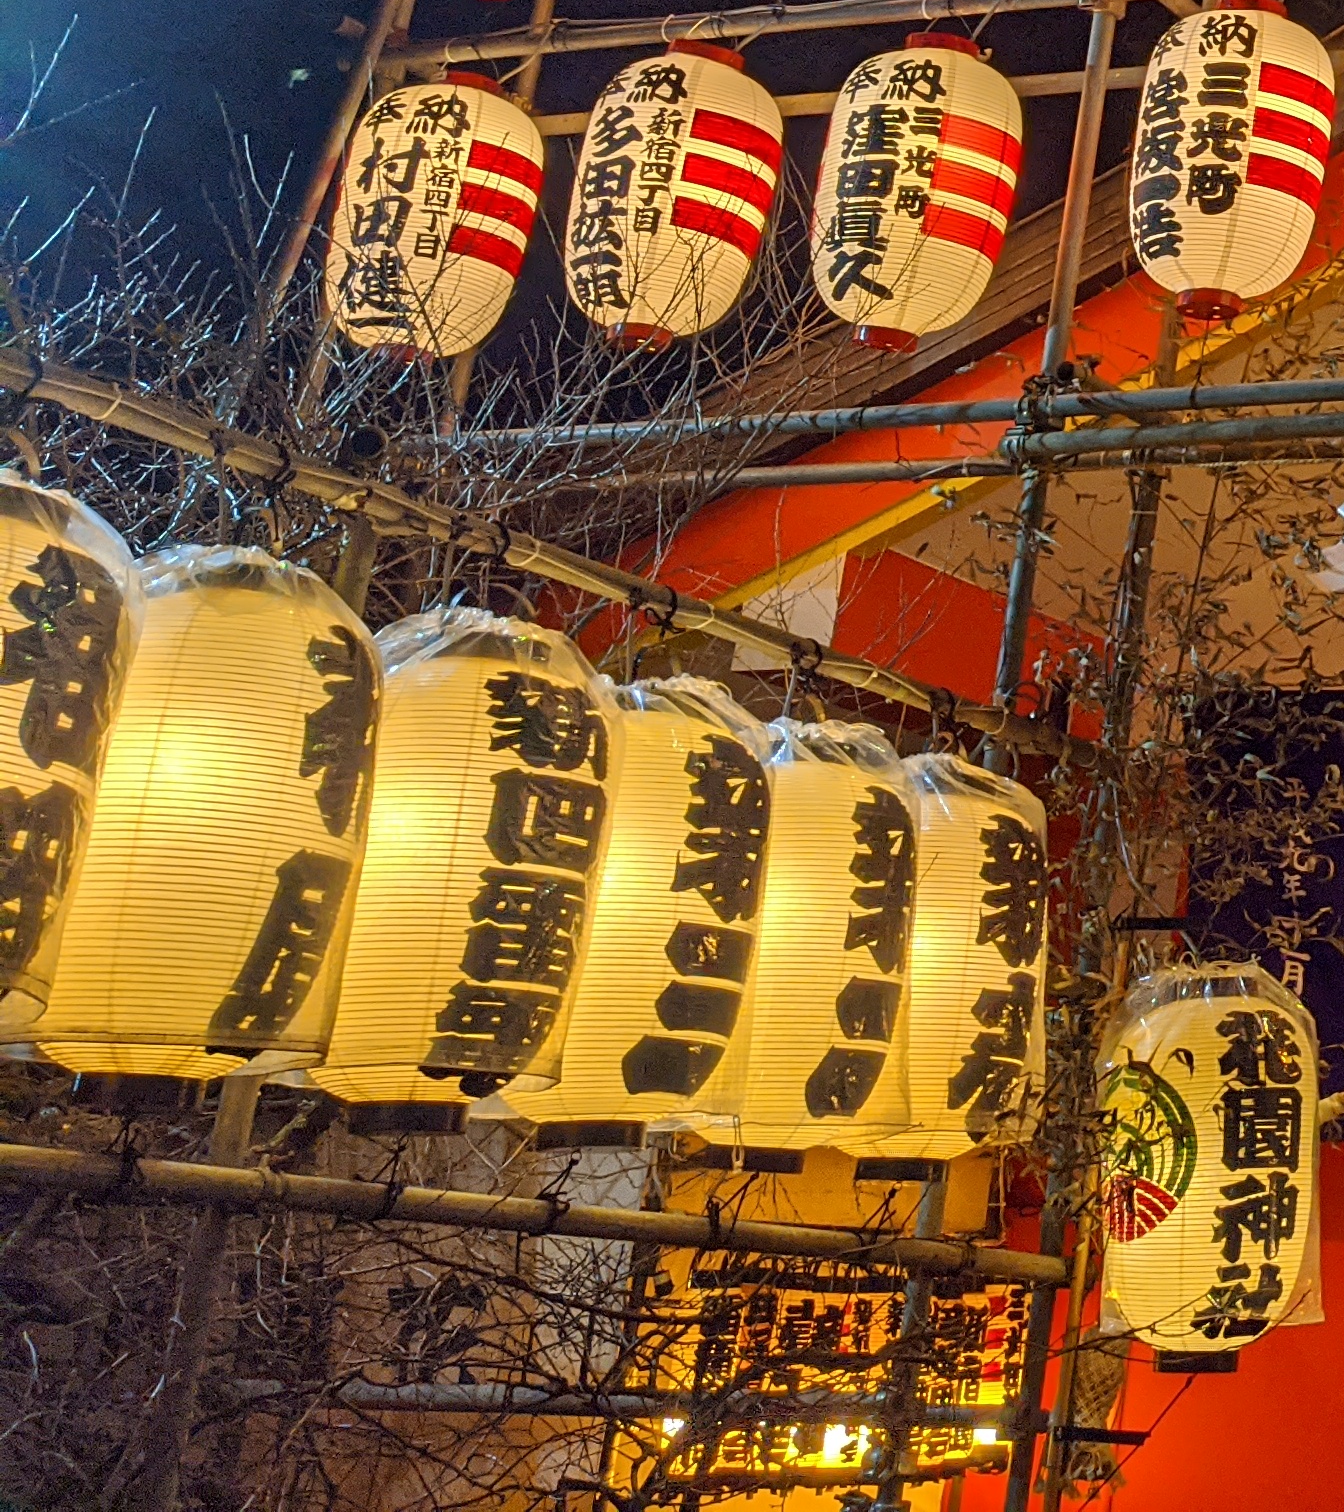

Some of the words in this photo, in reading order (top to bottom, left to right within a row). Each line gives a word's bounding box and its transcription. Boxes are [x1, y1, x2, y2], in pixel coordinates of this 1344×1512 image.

[840, 57, 948, 105] 奉納
[1150, 13, 1259, 67] 奉納
[360, 89, 472, 140] 奉納
[600, 62, 689, 108] 奉納
[413, 137, 465, 262] 新宿四丁目
[632, 106, 687, 238] 新宿四丁目
[892, 106, 946, 220] 三光町
[1189, 1007, 1303, 1341] 花園神社
